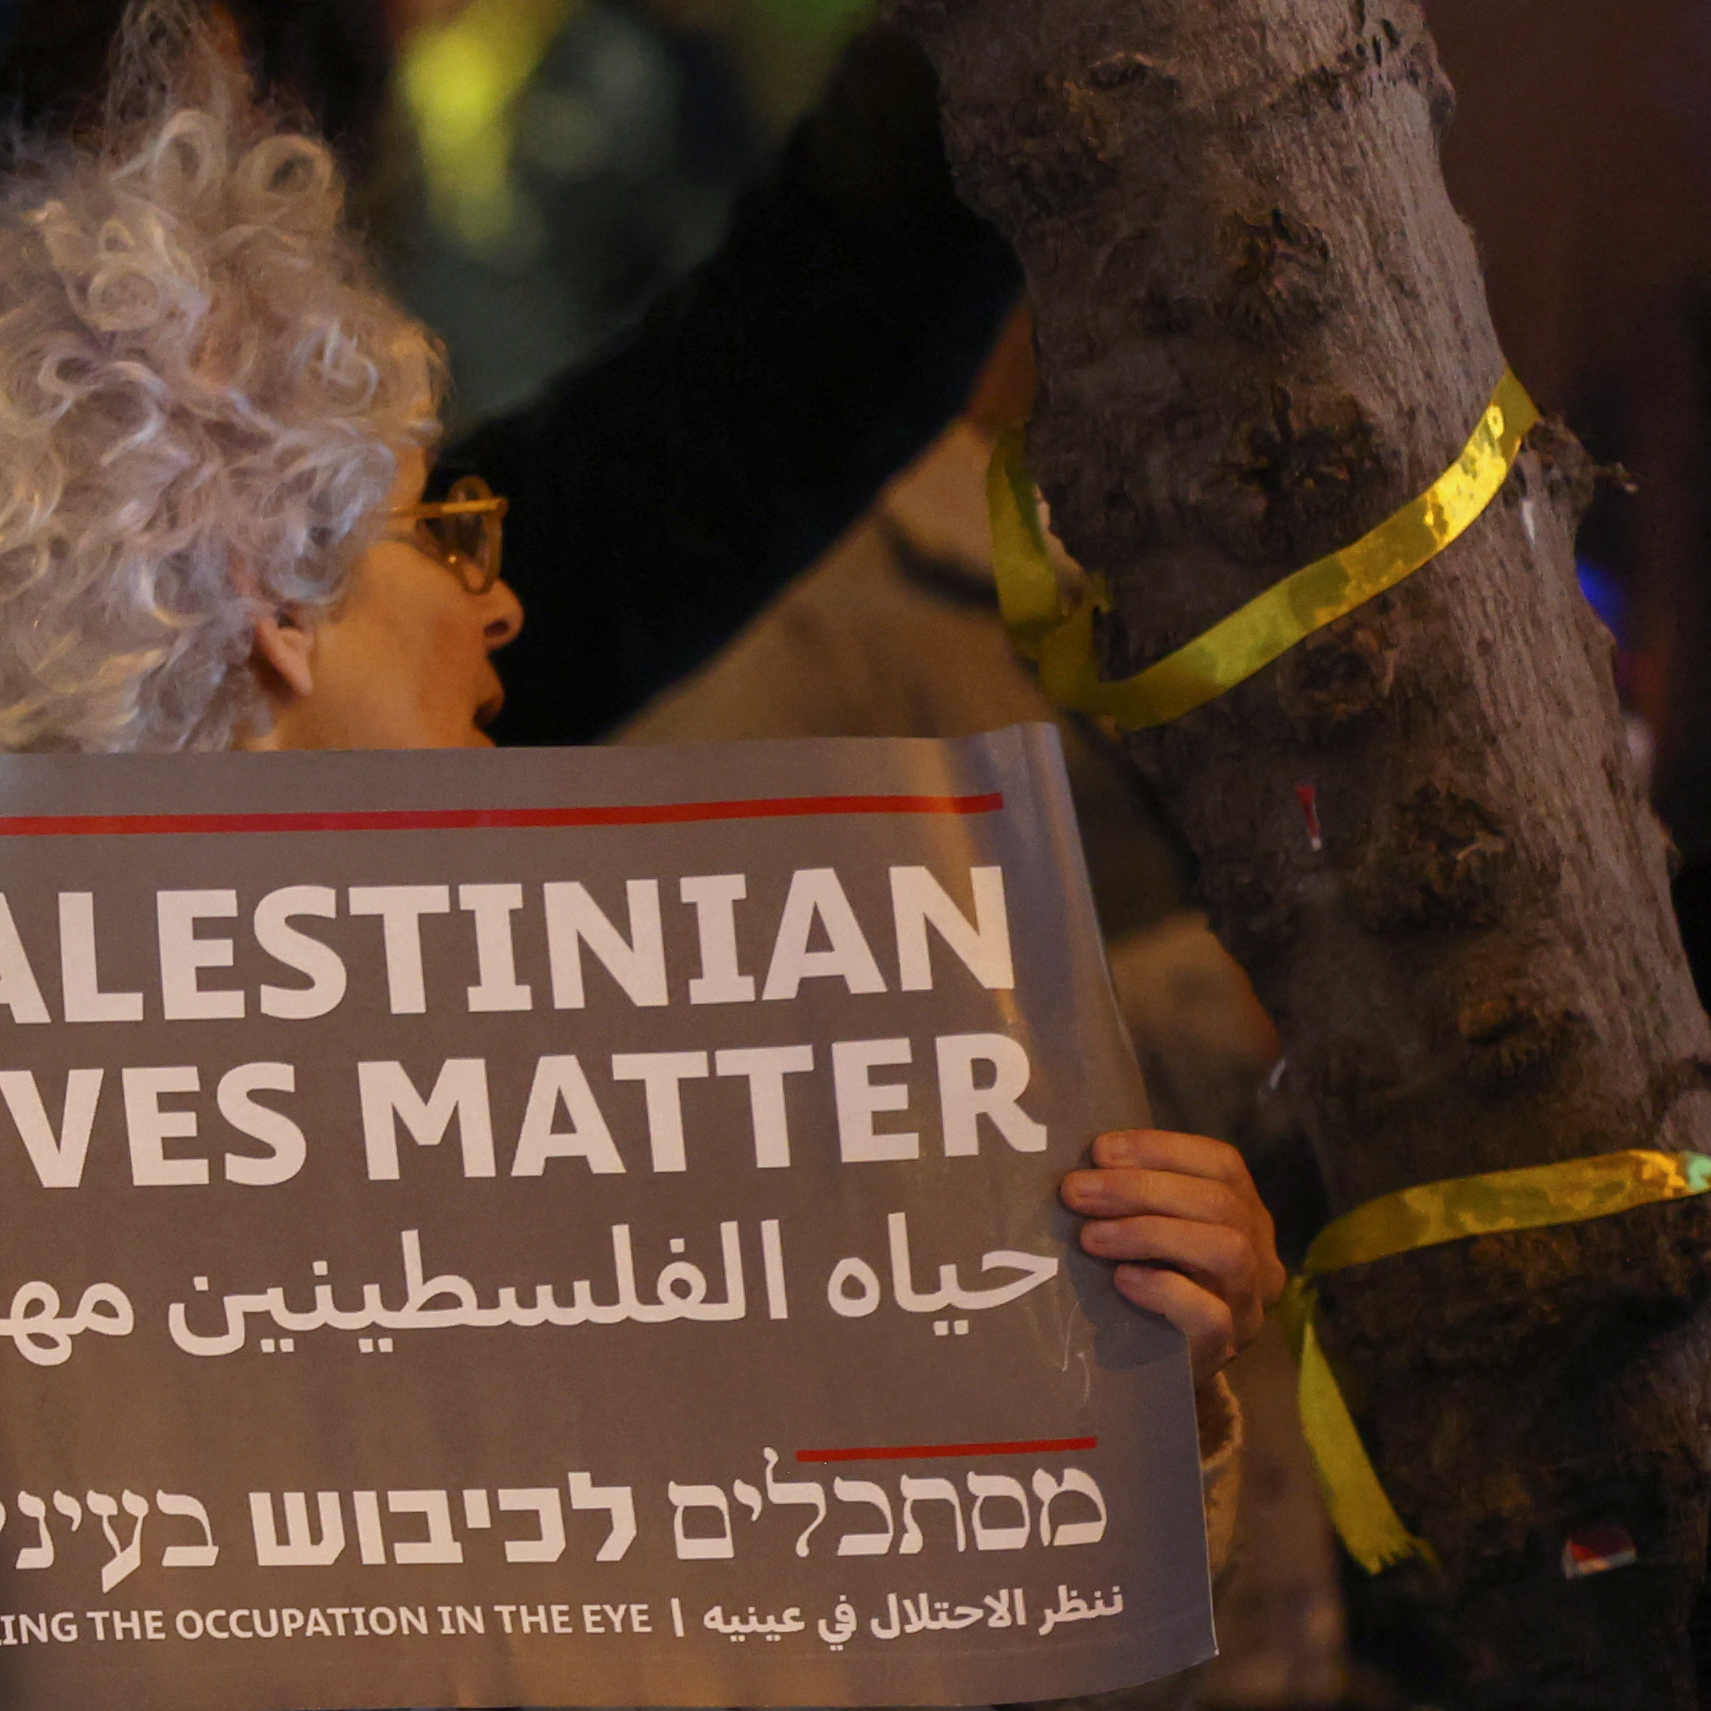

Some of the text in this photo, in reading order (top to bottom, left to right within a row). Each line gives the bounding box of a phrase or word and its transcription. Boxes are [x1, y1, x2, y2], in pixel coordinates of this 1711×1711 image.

[356, 1033, 1048, 1182] MATTER
[168, 1219, 789, 1357] الفلسطينين
[827, 1212, 1059, 1337] حياه
[248, 1471, 637, 1567] לכיבוש
[667, 1446, 1108, 1560] מסתכלים
[87, 1609, 167, 1641] THE
[175, 1605, 429, 1640] OCCUPATION
[439, 1604, 485, 1636] IN
[494, 1603, 574, 1635] THE
[583, 1602, 653, 1635] EYE
[702, 1583, 1125, 1652] ننظر الاحتلال في عينيه
